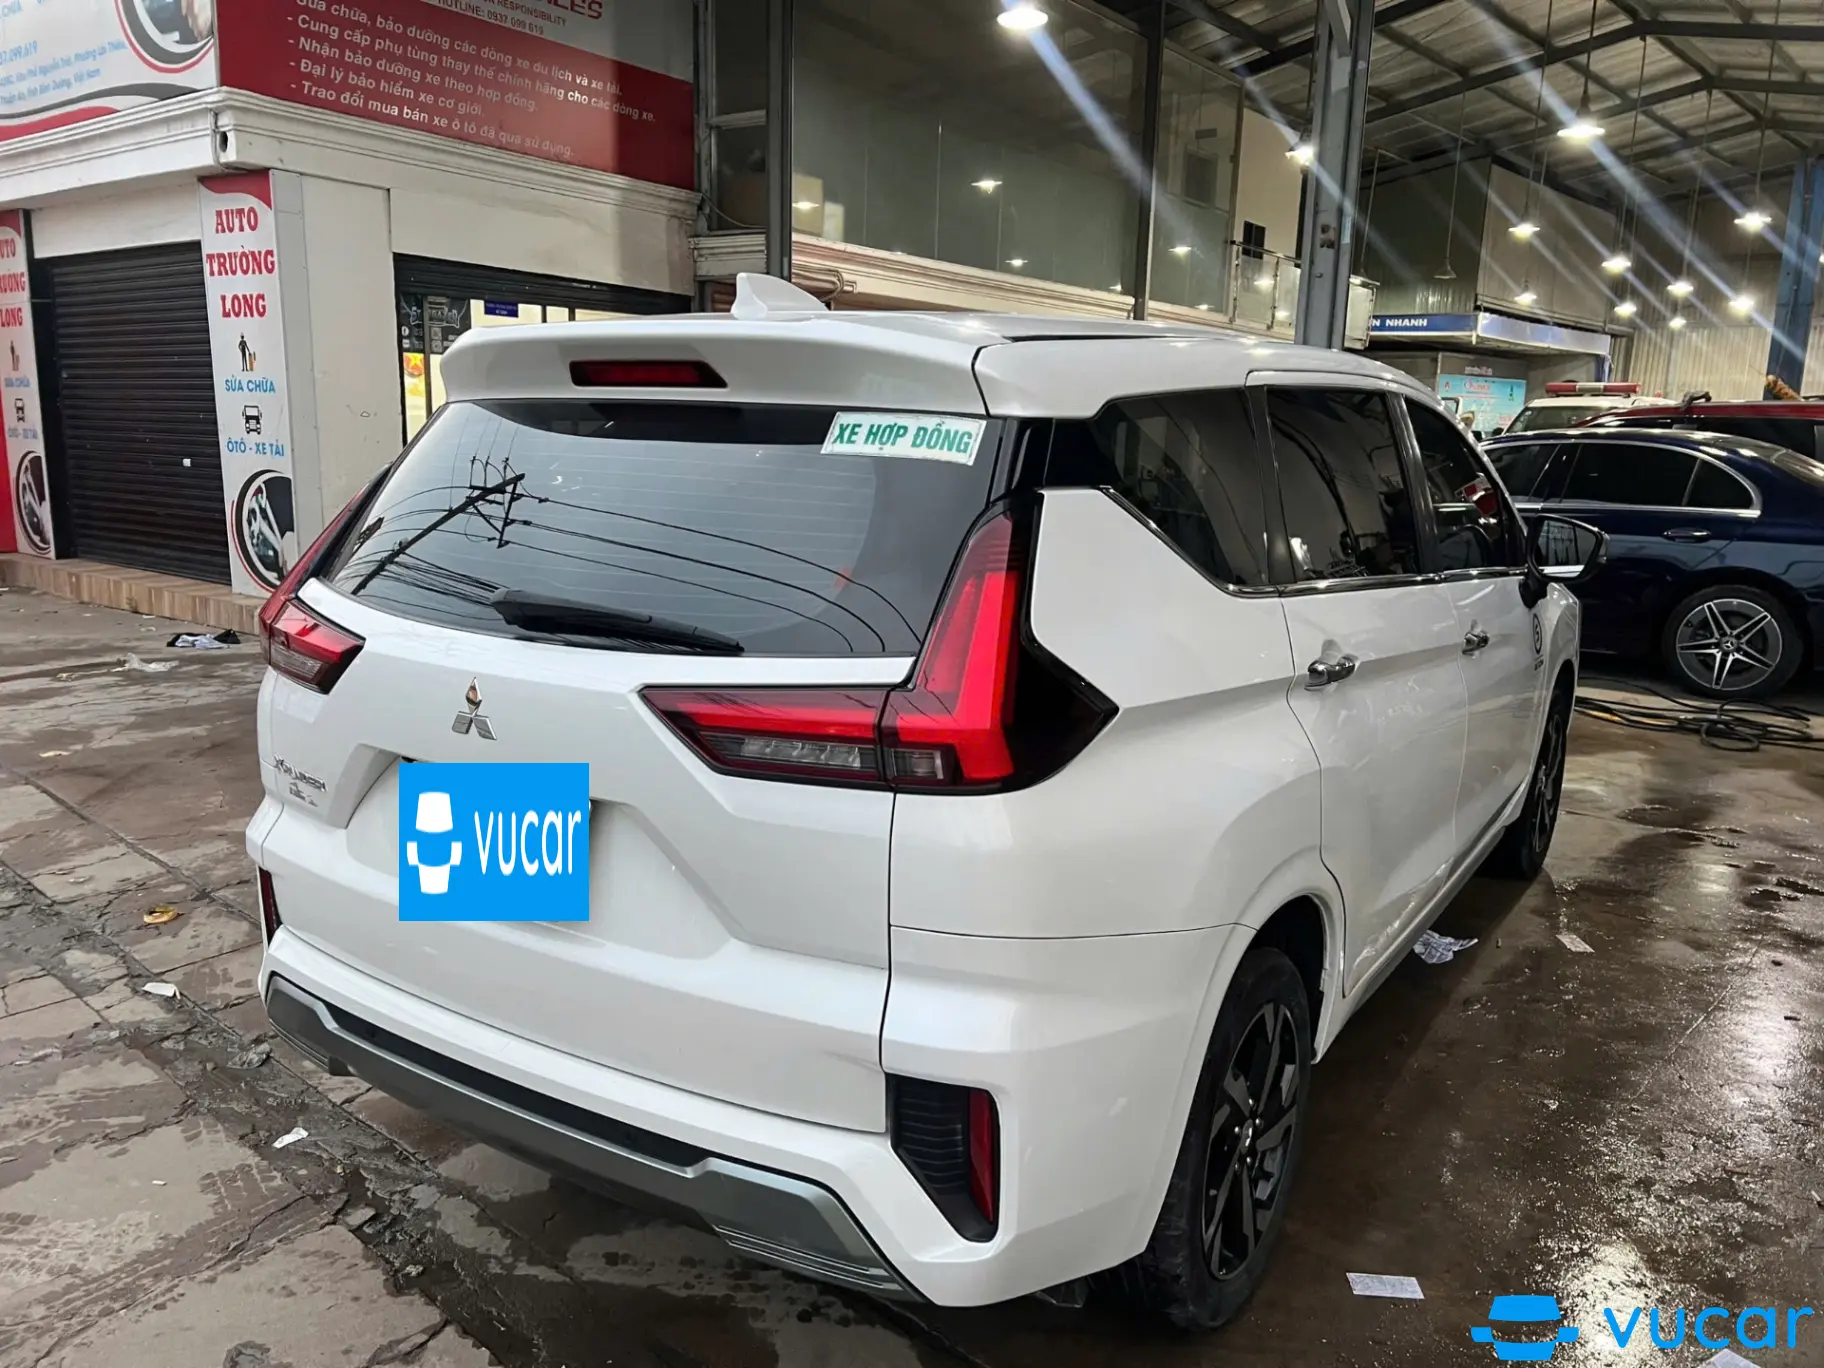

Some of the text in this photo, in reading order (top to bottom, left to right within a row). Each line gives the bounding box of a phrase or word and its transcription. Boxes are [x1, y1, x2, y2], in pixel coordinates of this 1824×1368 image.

[487, 10, 508, 23] 0937
[298, 14, 339, 39] Cung
[344, 29, 371, 47] cấp
[374, 38, 403, 56] phụ
[407, 45, 438, 67] tùng
[442, 55, 471, 75] thay
[568, 90, 589, 104] cho
[299, 36, 340, 58] Nhận
[344, 49, 372, 67] bảo
[376, 58, 421, 83] dưỡng
[425, 72, 440, 85] xe
[445, 76, 473, 93] theo
[376, 14, 403, 33] bảo
[407, 25, 450, 49] dưỡng
[454, 40, 477, 54] các
[517, 58, 530, 69] xe
[576, 74, 588, 86] và
[591, 79, 603, 89] xe
[300, 58, 326, 78] Đại
[330, 66, 344, 84] lý
[348, 71, 376, 89] bảo
[379, 79, 414, 99] hiểm
[419, 91, 434, 104] xe
[438, 97, 454, 108] cơ
[301, 80, 336, 101] Trao
[340, 90, 364, 108] đổi
[368, 100, 399, 116] mua
[403, 105, 429, 123] bán
[432, 115, 448, 127] xe
[215, 206, 258, 234] AUTO
[220, 293, 266, 318] LONG
[1385, 319, 1428, 327] NHANH
[225, 374, 276, 393] SỬA CHỮA
[227, 437, 246, 453] ÔTÔ
[254, 442, 267, 455] XE
[269, 438, 284, 456] TẢI
[832, 421, 973, 454] XE HỢP ĐỒNG
